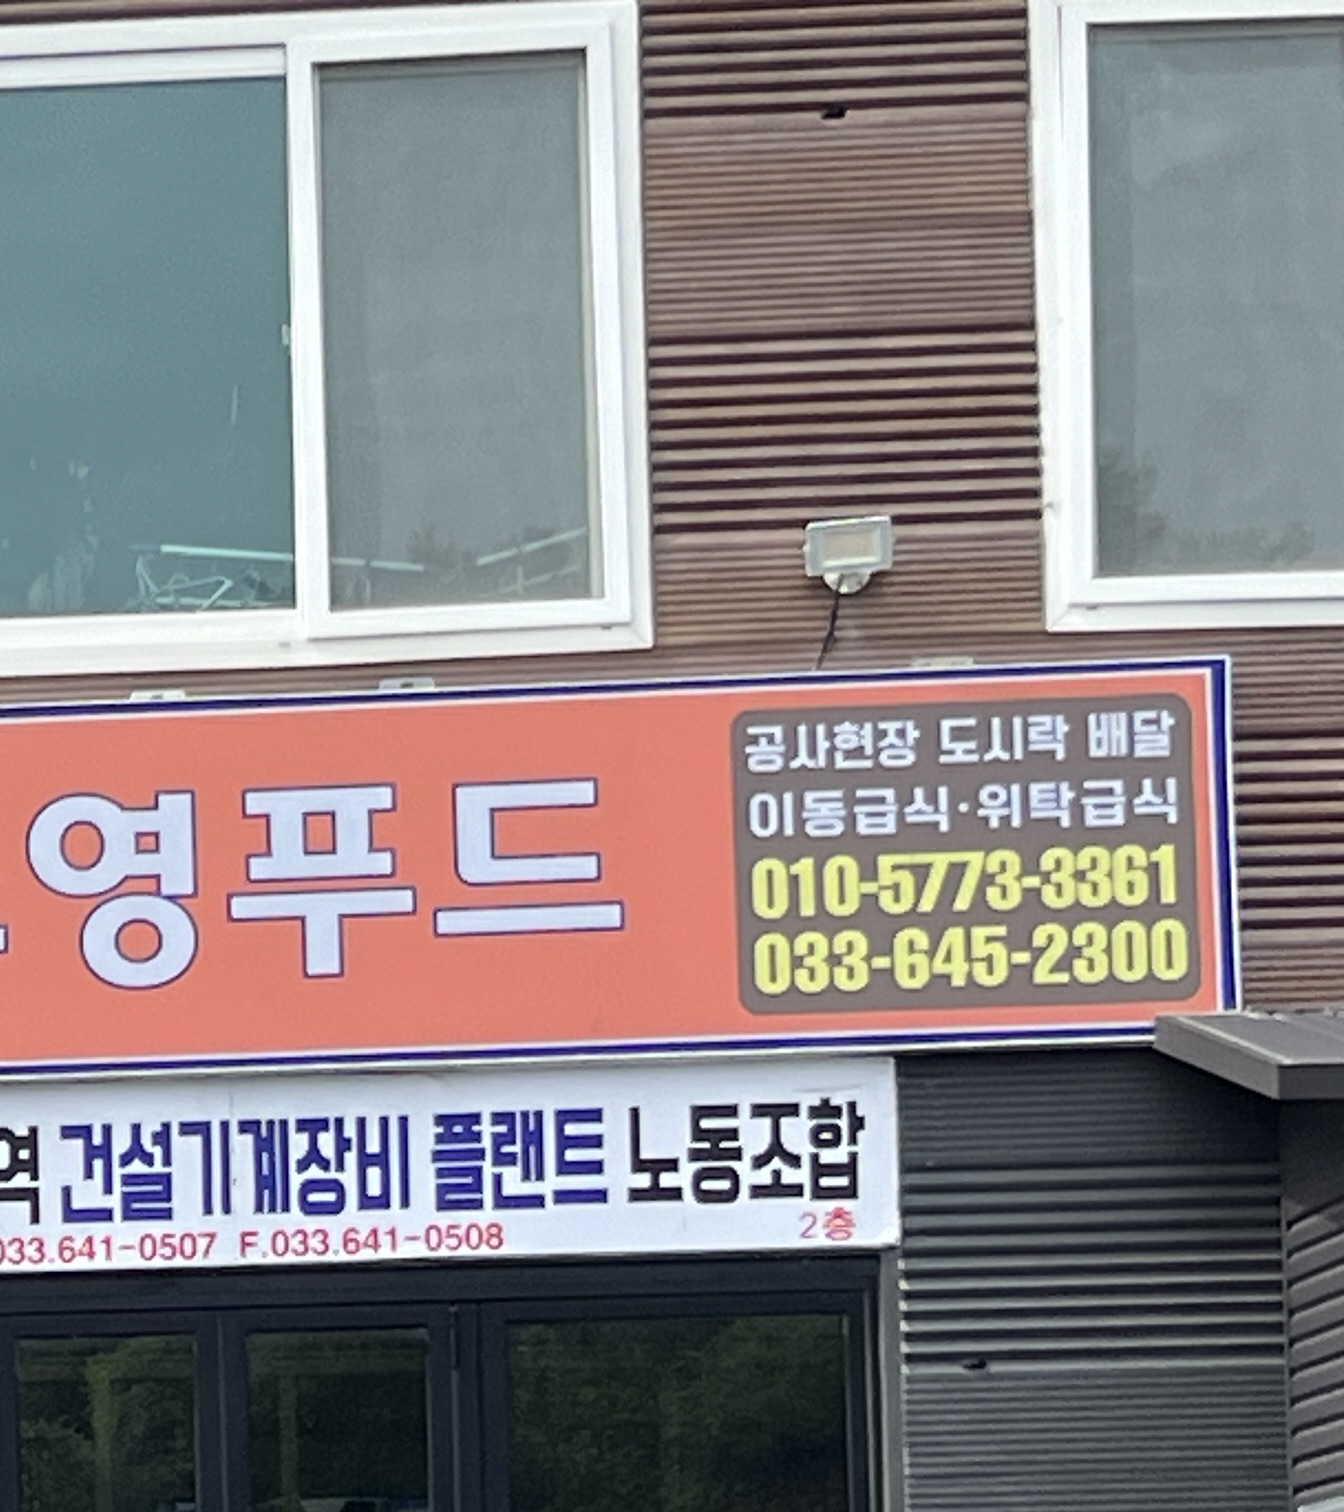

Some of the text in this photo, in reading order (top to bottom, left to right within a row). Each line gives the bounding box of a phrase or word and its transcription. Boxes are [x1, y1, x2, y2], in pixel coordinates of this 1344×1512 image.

[744, 708, 1176, 774] 공사현장 도시락 배달
[751, 843, 1178, 920] 010-5773-3361
[753, 918, 1189, 995] 033-645-2300
[59, 1114, 410, 1225] 건설기계장비
[431, 1106, 609, 1213] 플랜트
[626, 1096, 867, 1205] 노동조합
[798, 1206, 858, 1241] 2층
